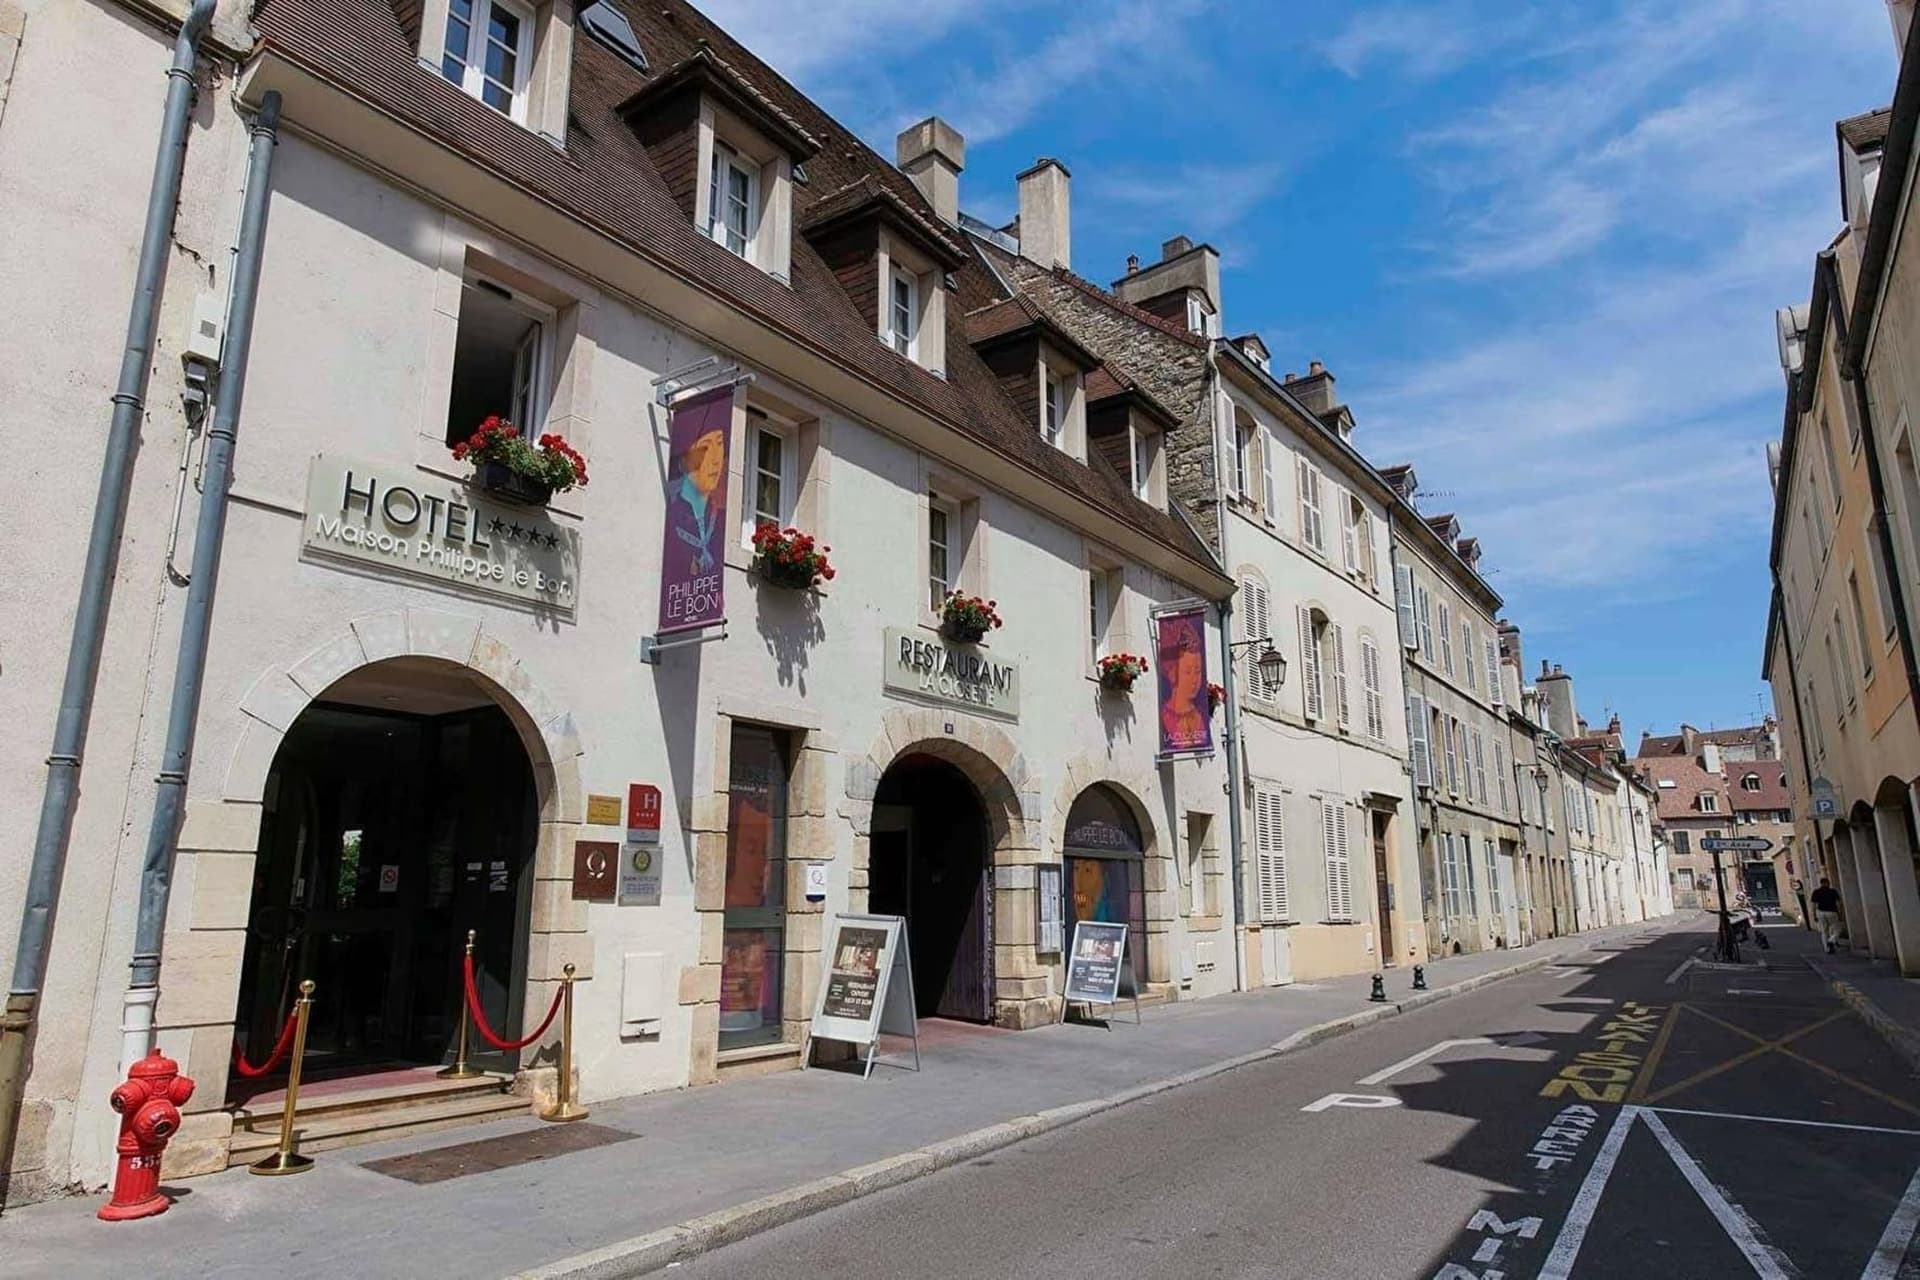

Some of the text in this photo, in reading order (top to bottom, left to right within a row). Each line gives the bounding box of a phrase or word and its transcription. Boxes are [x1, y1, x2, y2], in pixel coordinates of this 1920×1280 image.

[343, 470, 490, 549] HOTEL
[315, 513, 573, 597] Maison Philippe le Bon
[669, 575, 719, 600] PHILIPPE
[668, 592, 719, 618] LE BON
[899, 636, 1014, 691] RESTAURANT
[920, 671, 936, 692] LA
[644, 793, 658, 809] H
[1819, 801, 1830, 811] P
[1300, 1093, 1403, 1112] P
